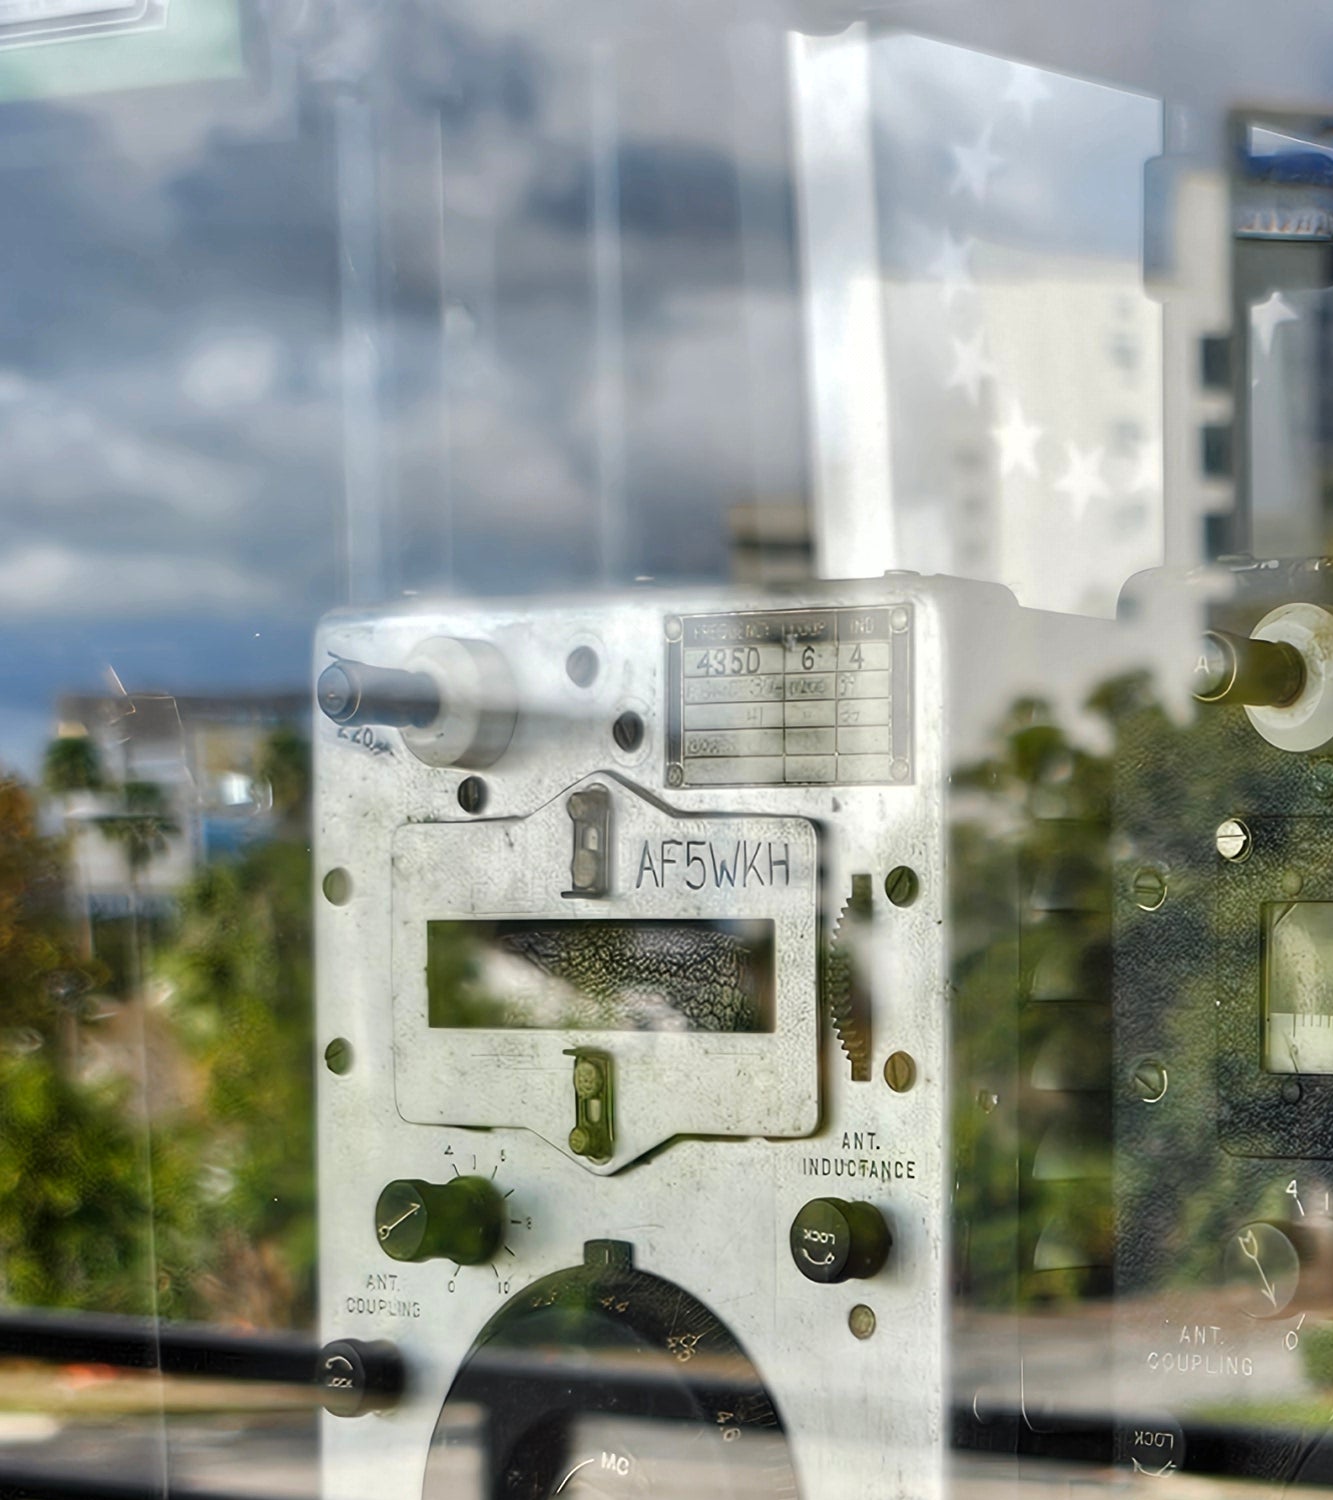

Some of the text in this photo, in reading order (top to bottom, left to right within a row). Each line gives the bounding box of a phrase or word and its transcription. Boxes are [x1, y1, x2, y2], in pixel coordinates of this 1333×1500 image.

[636, 841, 790, 889] AF5WKH
[842, 1132, 880, 1150] ANT.
[803, 1158, 915, 1179] INDUCTANCE
[1286, 1179, 1298, 1196] 4
[366, 1274, 400, 1293] ANT.
[448, 1280, 510, 1294] 0 10
[347, 1297, 421, 1318] COUPLING
[1179, 1325, 1224, 1345] ANT.
[1286, 1331, 1299, 1350] 0
[1147, 1352, 1253, 1377] COUPLING
[1134, 1431, 1174, 1449] LOCK
[601, 1452, 630, 1475] MC
